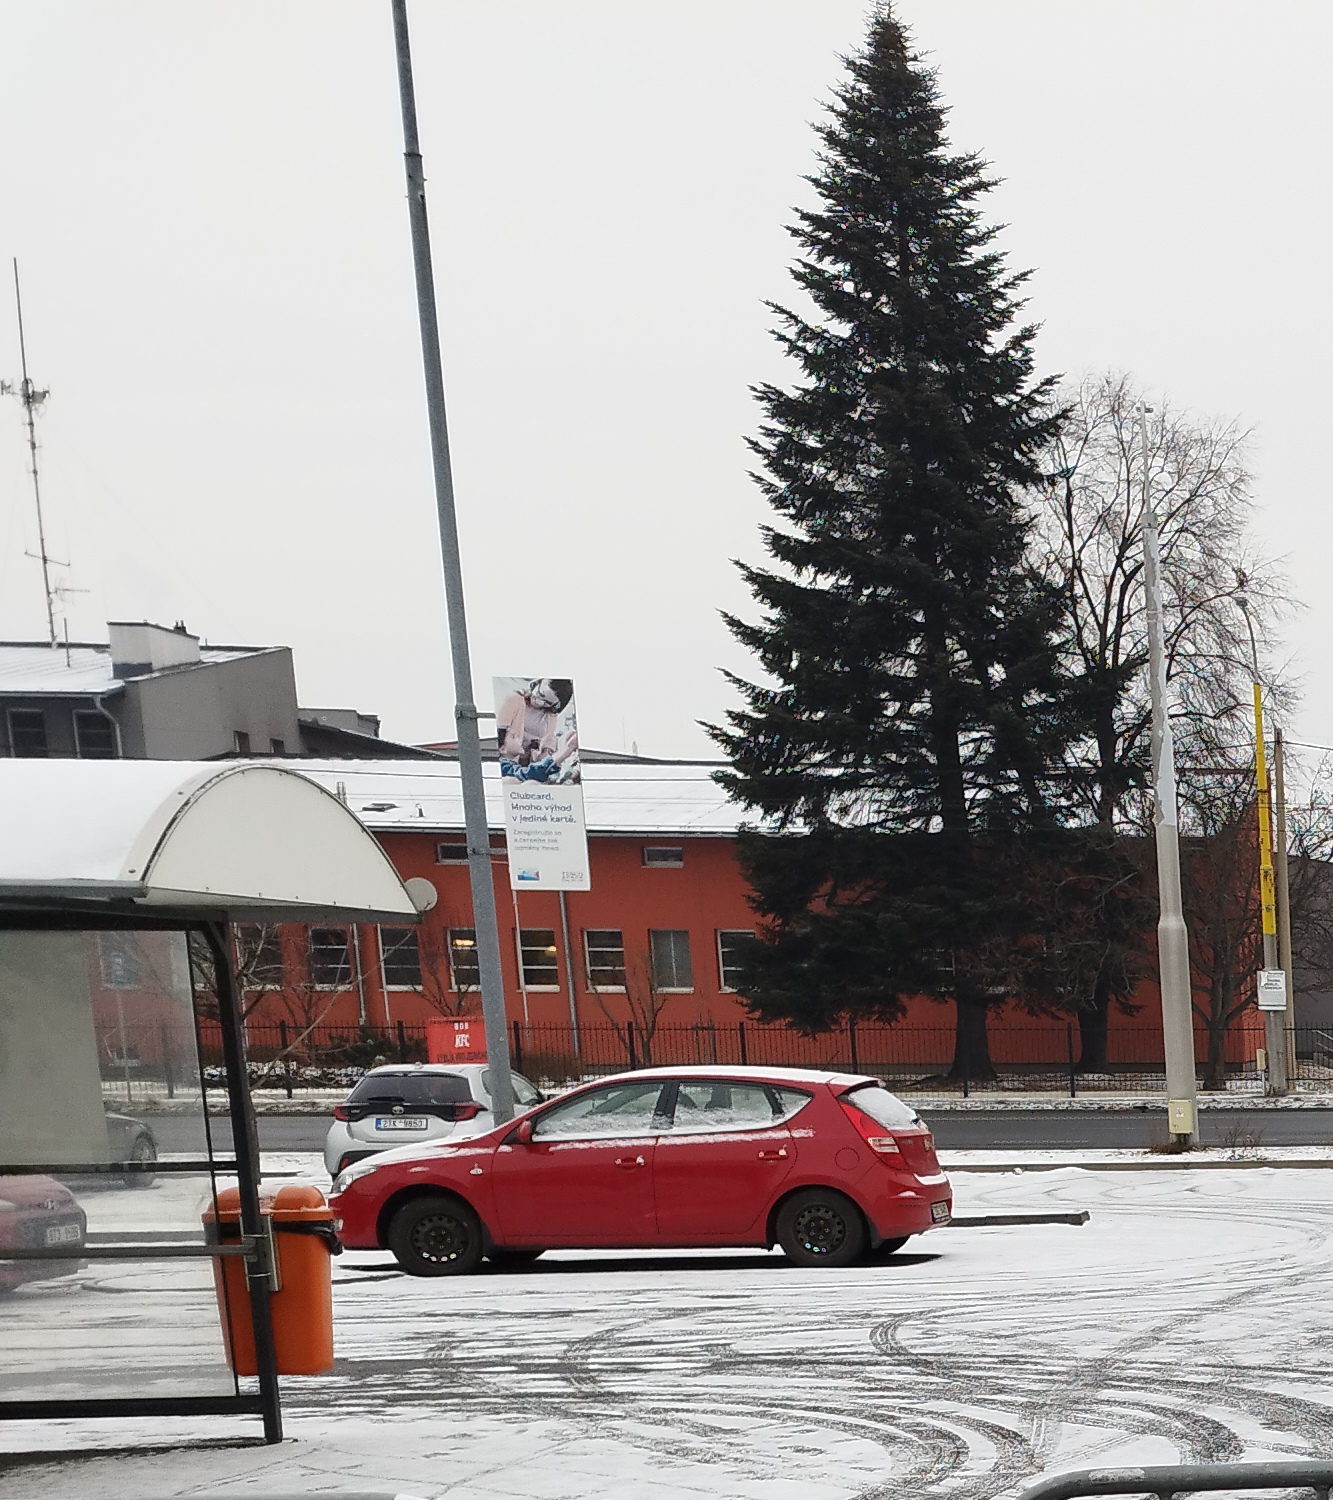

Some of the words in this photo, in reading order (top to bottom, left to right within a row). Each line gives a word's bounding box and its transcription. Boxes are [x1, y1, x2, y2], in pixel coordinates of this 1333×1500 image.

[510, 792, 554, 800] Clubcard.
[511, 803, 542, 811] Mnoho
[544, 804, 572, 812] výhod
